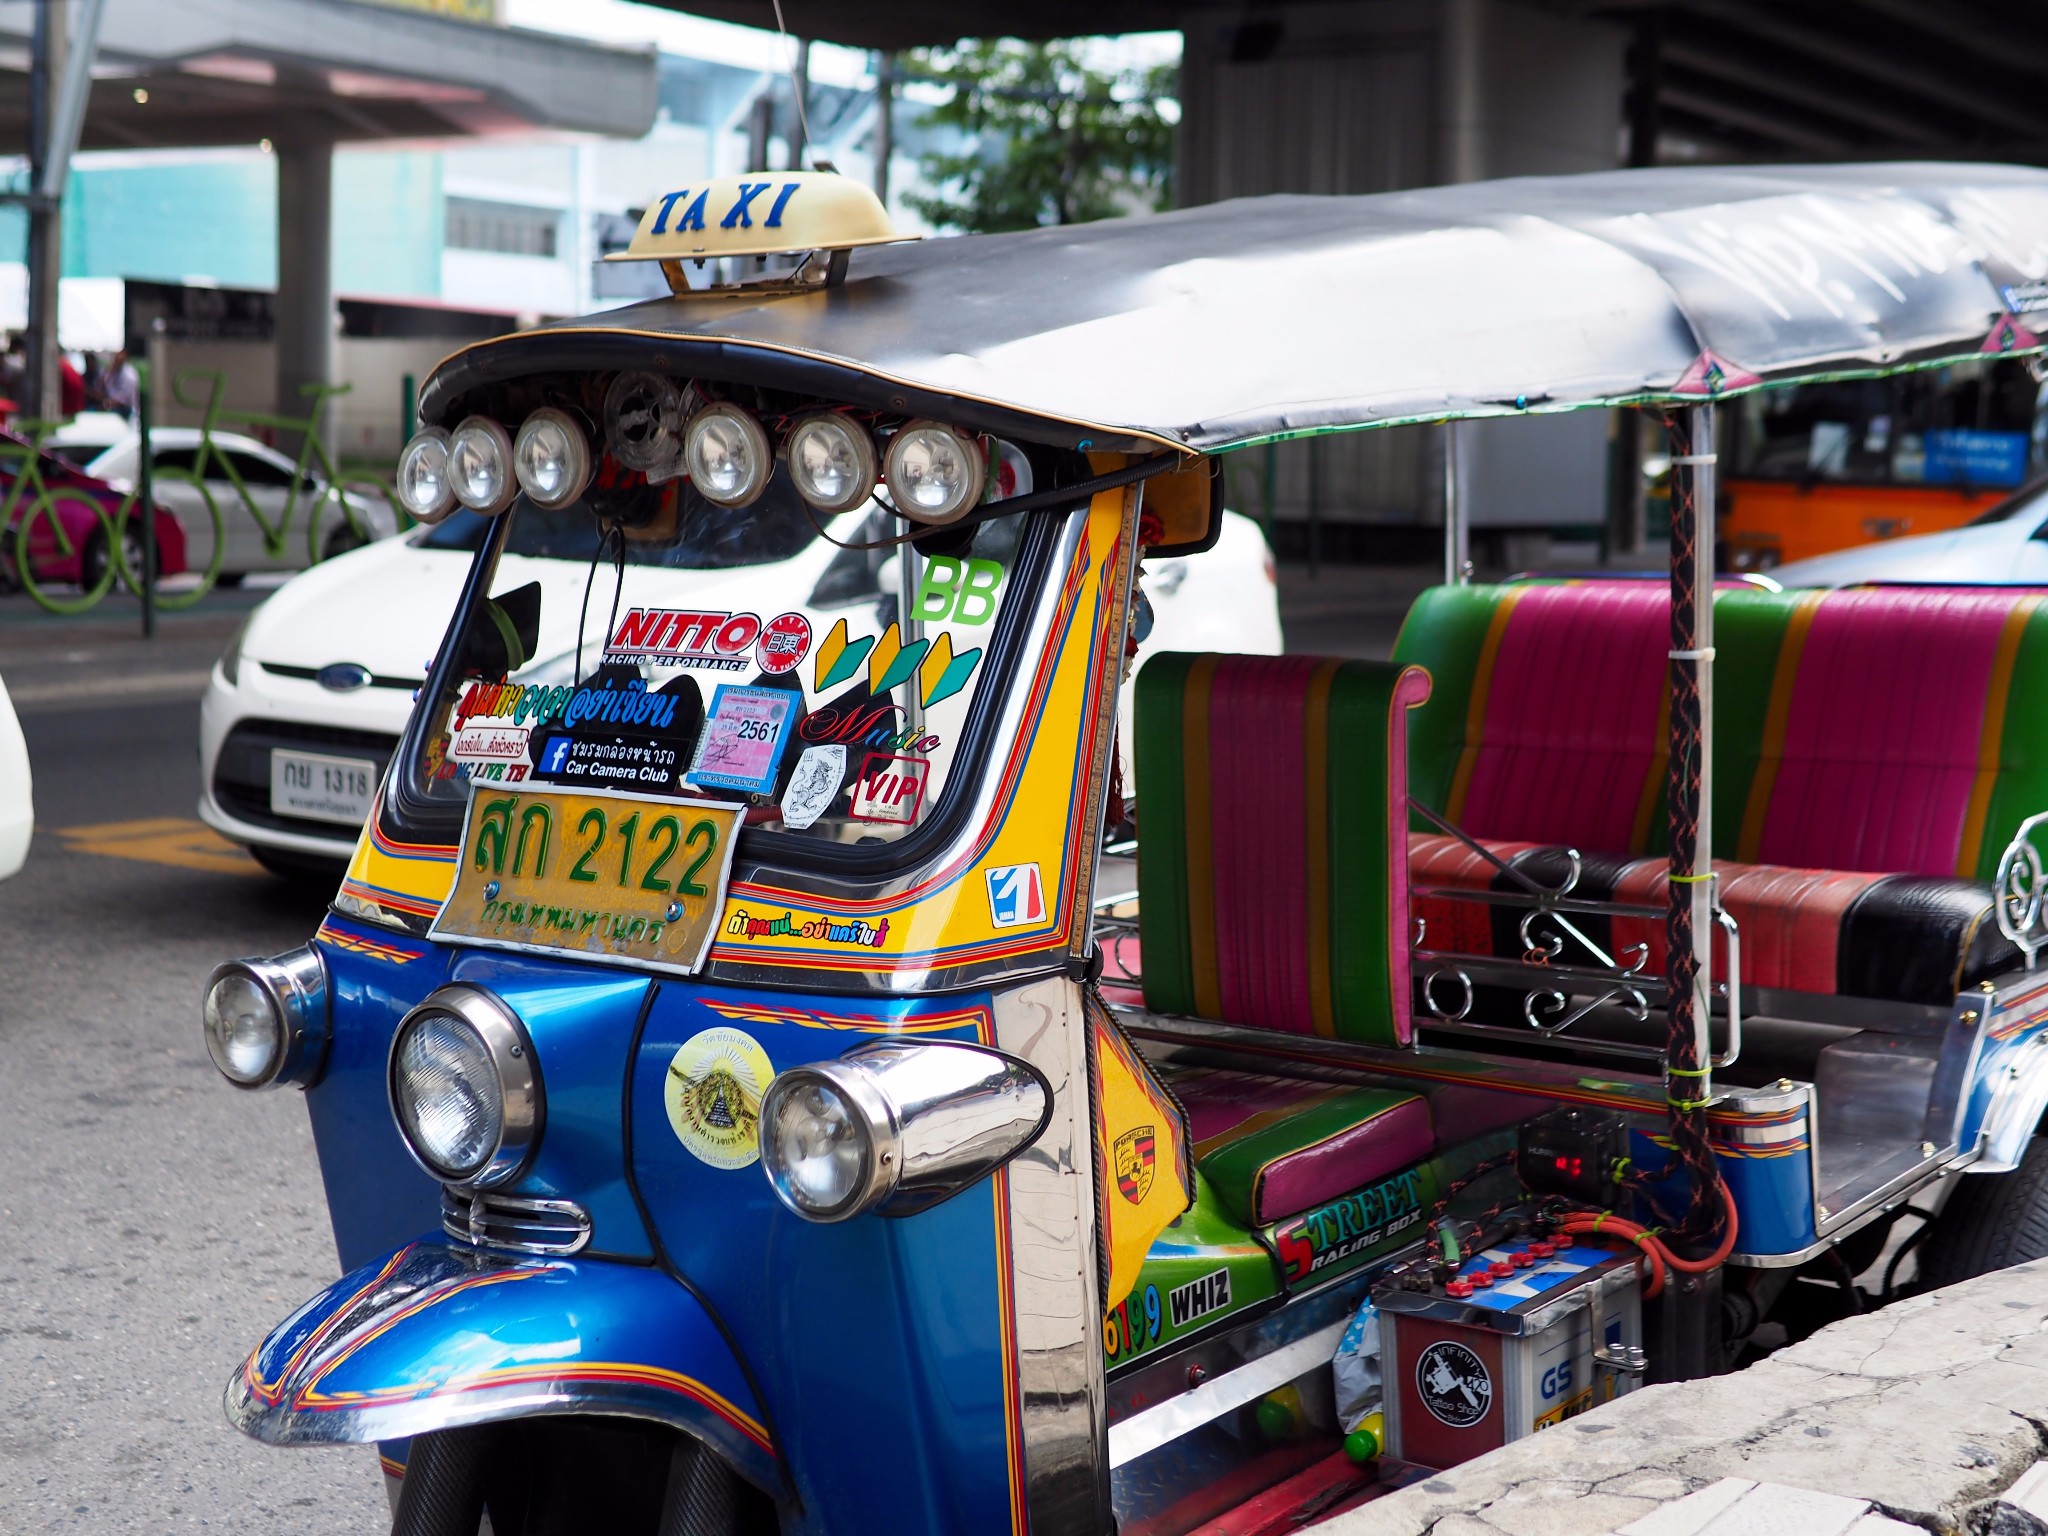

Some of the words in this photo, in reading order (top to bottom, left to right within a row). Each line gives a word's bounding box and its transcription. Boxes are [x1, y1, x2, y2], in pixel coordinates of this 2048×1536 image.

[651, 182, 801, 235] TAXI
[910, 554, 1004, 626] BB
[608, 608, 762, 655] NITTO
[766, 633, 802, 655] 日東
[600, 654, 647, 665] RACING
[649, 656, 748, 672] PERFORMANCE
[737, 719, 779, 743] 2561
[800, 703, 942, 754] Music
[323, 767, 367, 797] 1318
[566, 760, 588, 775] Car
[589, 762, 637, 779] Camera
[640, 766, 669, 783] Club
[865, 771, 919, 806] VIP
[475, 795, 554, 879] สก
[569, 807, 719, 898] 2122
[480, 899, 667, 946] กรุงเทพมหานคร
[1115, 1127, 1153, 1149] PORSCHE
[1311, 1229, 1382, 1272] RACING
[1386, 1209, 1422, 1237] BOX
[1171, 1270, 1228, 1326] WHIZ
[1438, 1346, 1484, 1378] INFINITY
[1541, 1359, 1573, 1400] GS
[1467, 1378, 1489, 1393] 420
[1428, 1395, 1454, 1411] Tattoo
[1457, 1402, 1479, 1417] Shop
